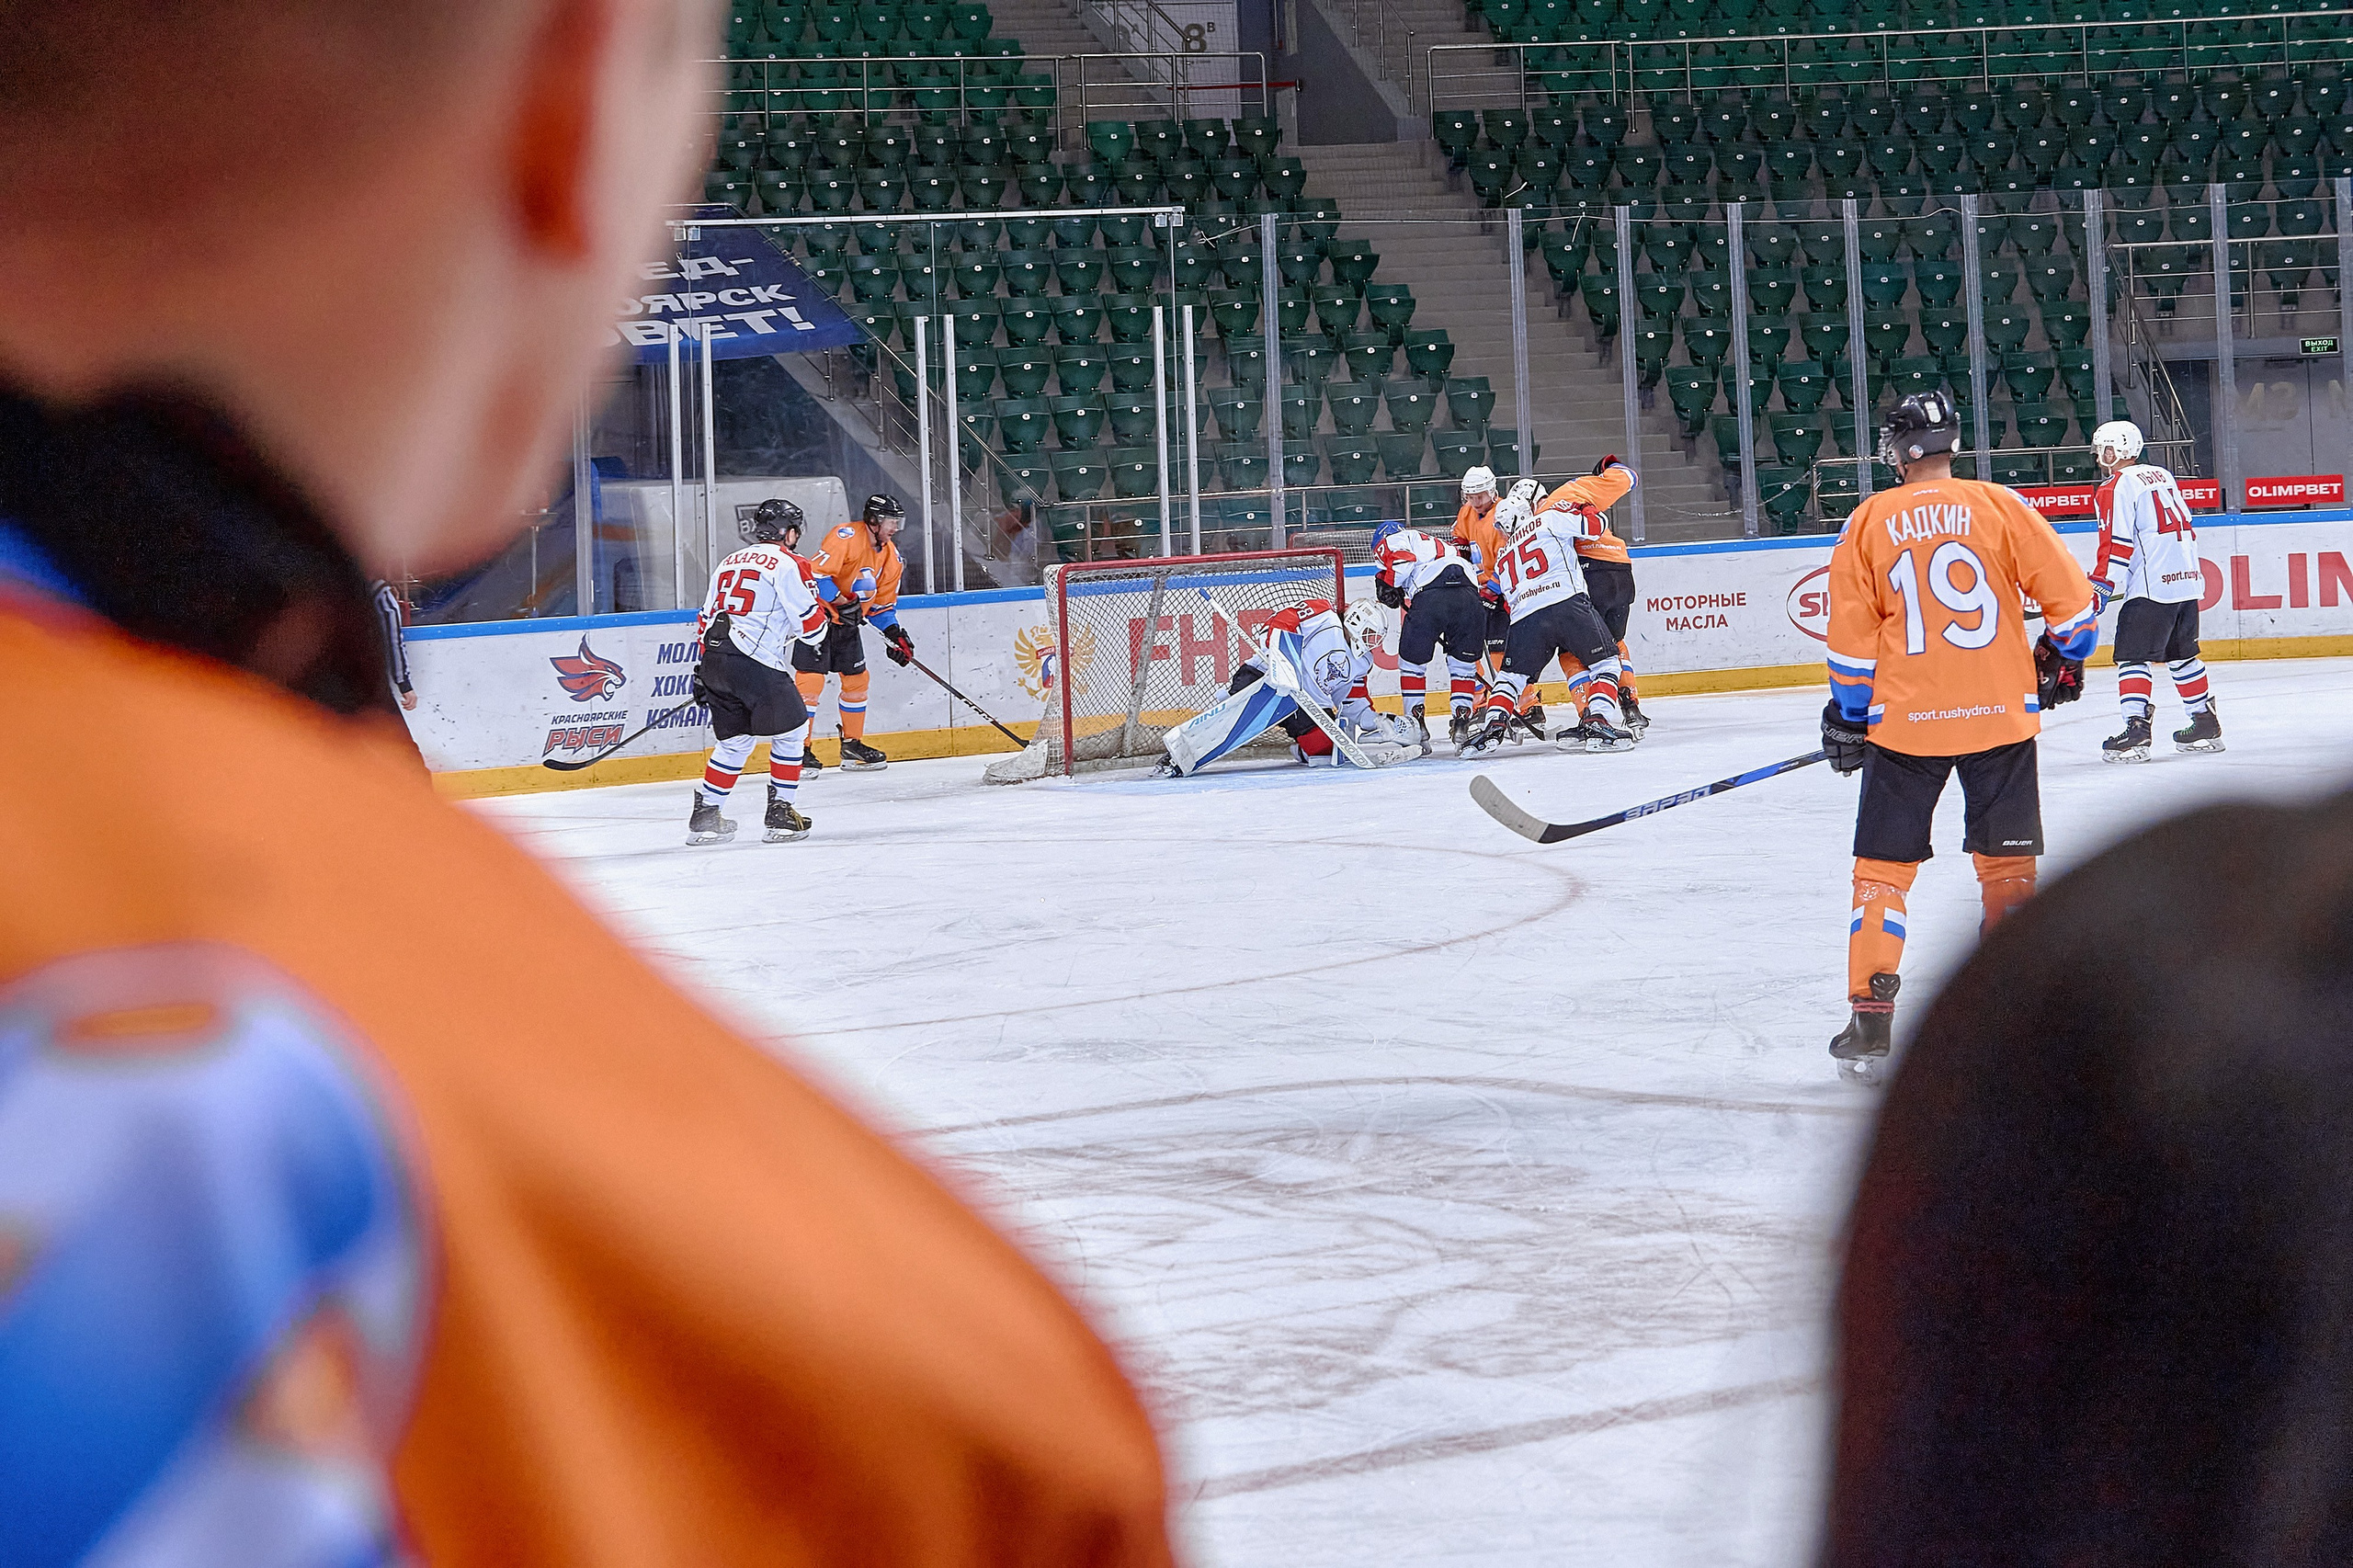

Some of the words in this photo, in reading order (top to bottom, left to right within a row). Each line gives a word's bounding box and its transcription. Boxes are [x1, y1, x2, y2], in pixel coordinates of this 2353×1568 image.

[2182, 488, 2217, 500] BET
[2248, 483, 2342, 497] OLIMPBET
[1885, 504, 1972, 546] КАДКИН
[2151, 488, 2197, 541] 44
[811, 549, 831, 566] 71
[1497, 533, 1549, 595] 75
[710, 569, 761, 619] 65
[1647, 592, 1746, 612] МОТОРНЫЕ
[1888, 540, 2000, 655] 19
[1665, 616, 1729, 632] МАСЛА
[656, 642, 702, 665] МОЛ
[551, 710, 629, 725] КРАСНОЯРСКИЕ
[1907, 703, 2006, 723] sport.rushydro.ru
[1291, 689, 1370, 767] SHERWOOD
[542, 723, 625, 757] РЫСИ
